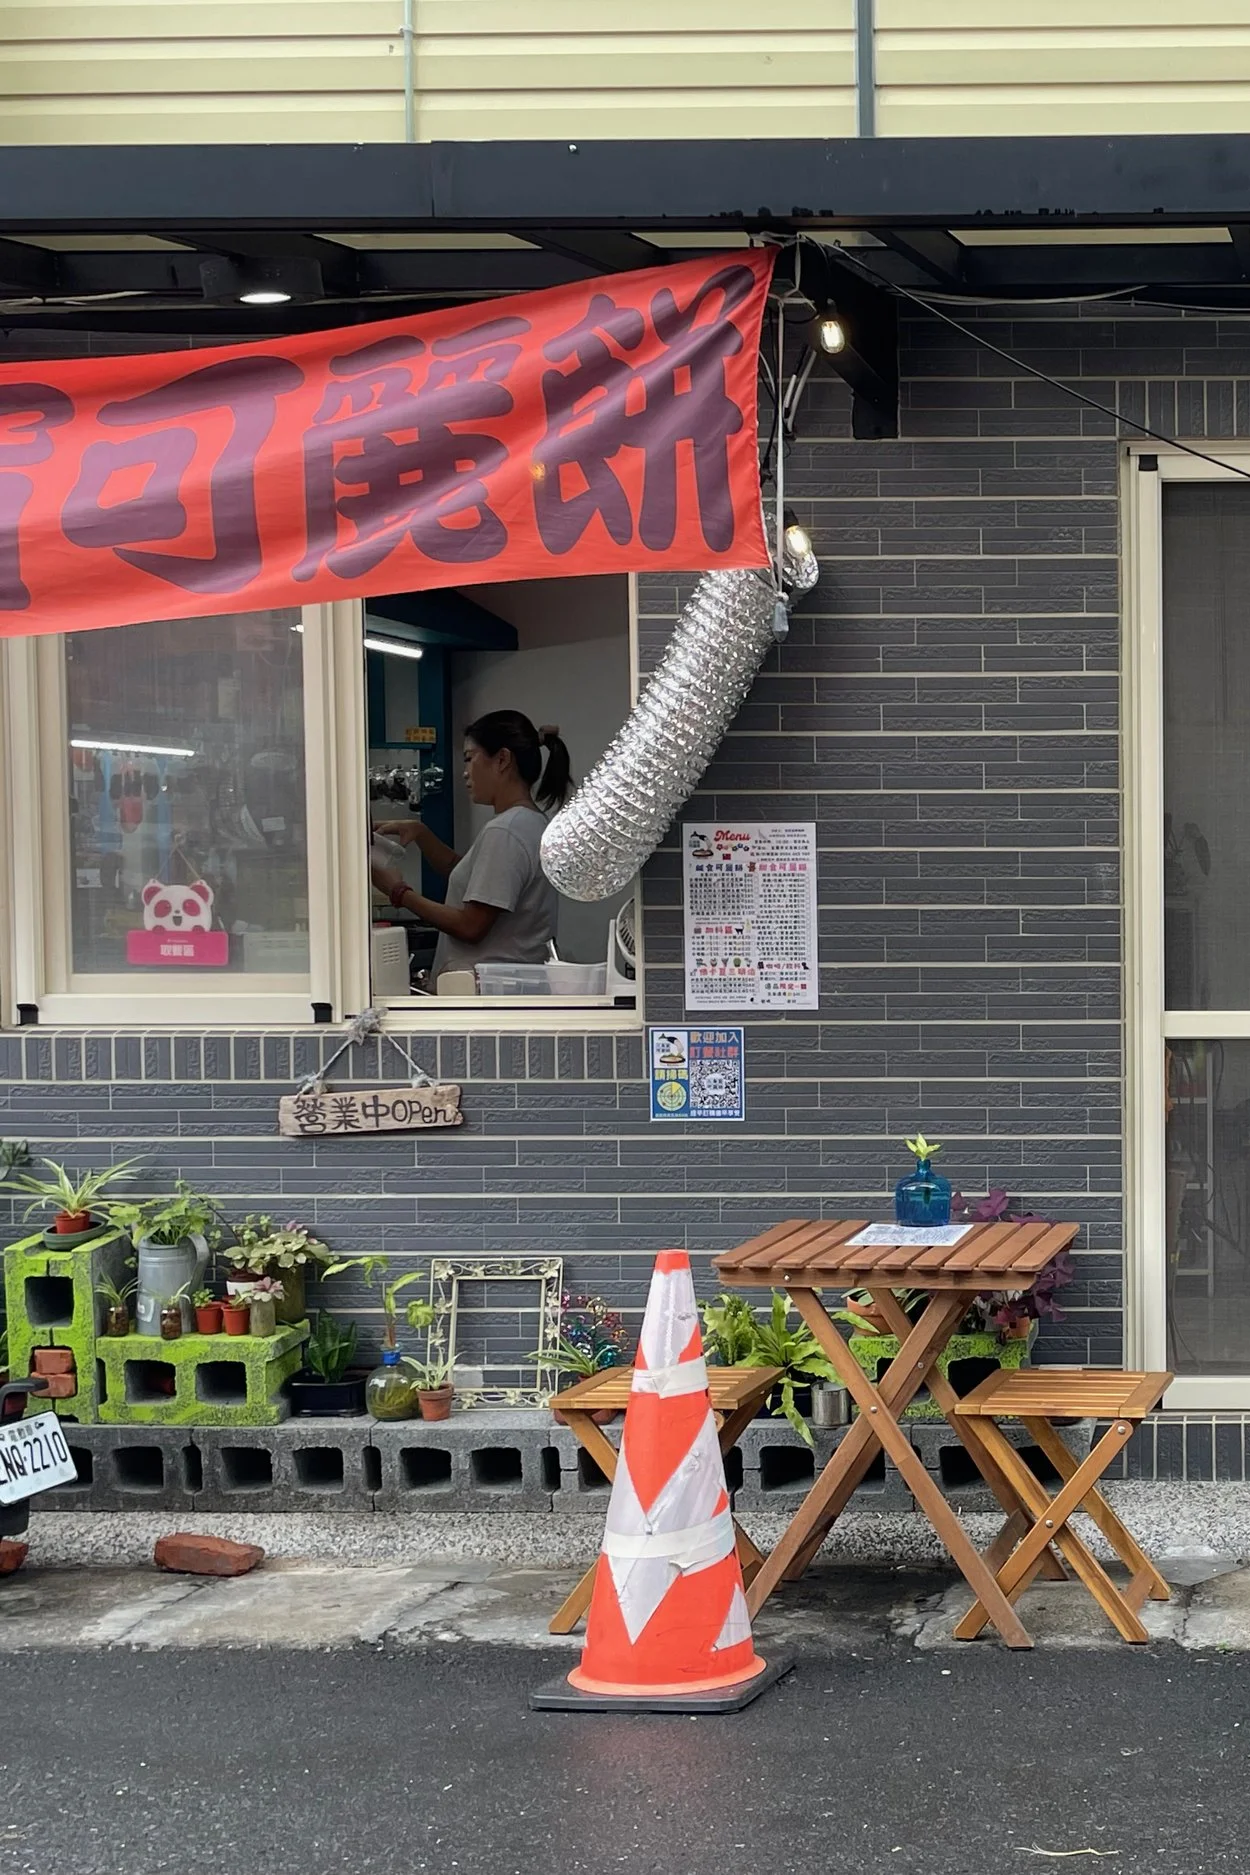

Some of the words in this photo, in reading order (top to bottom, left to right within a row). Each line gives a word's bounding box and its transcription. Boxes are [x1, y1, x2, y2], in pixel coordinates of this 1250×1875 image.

[0, 264, 756, 611] 可麗餅
[714, 829, 751, 842] Menu
[690, 1031, 739, 1043] 歡迎加入
[0, 1431, 68, 1485] NQ-2210
